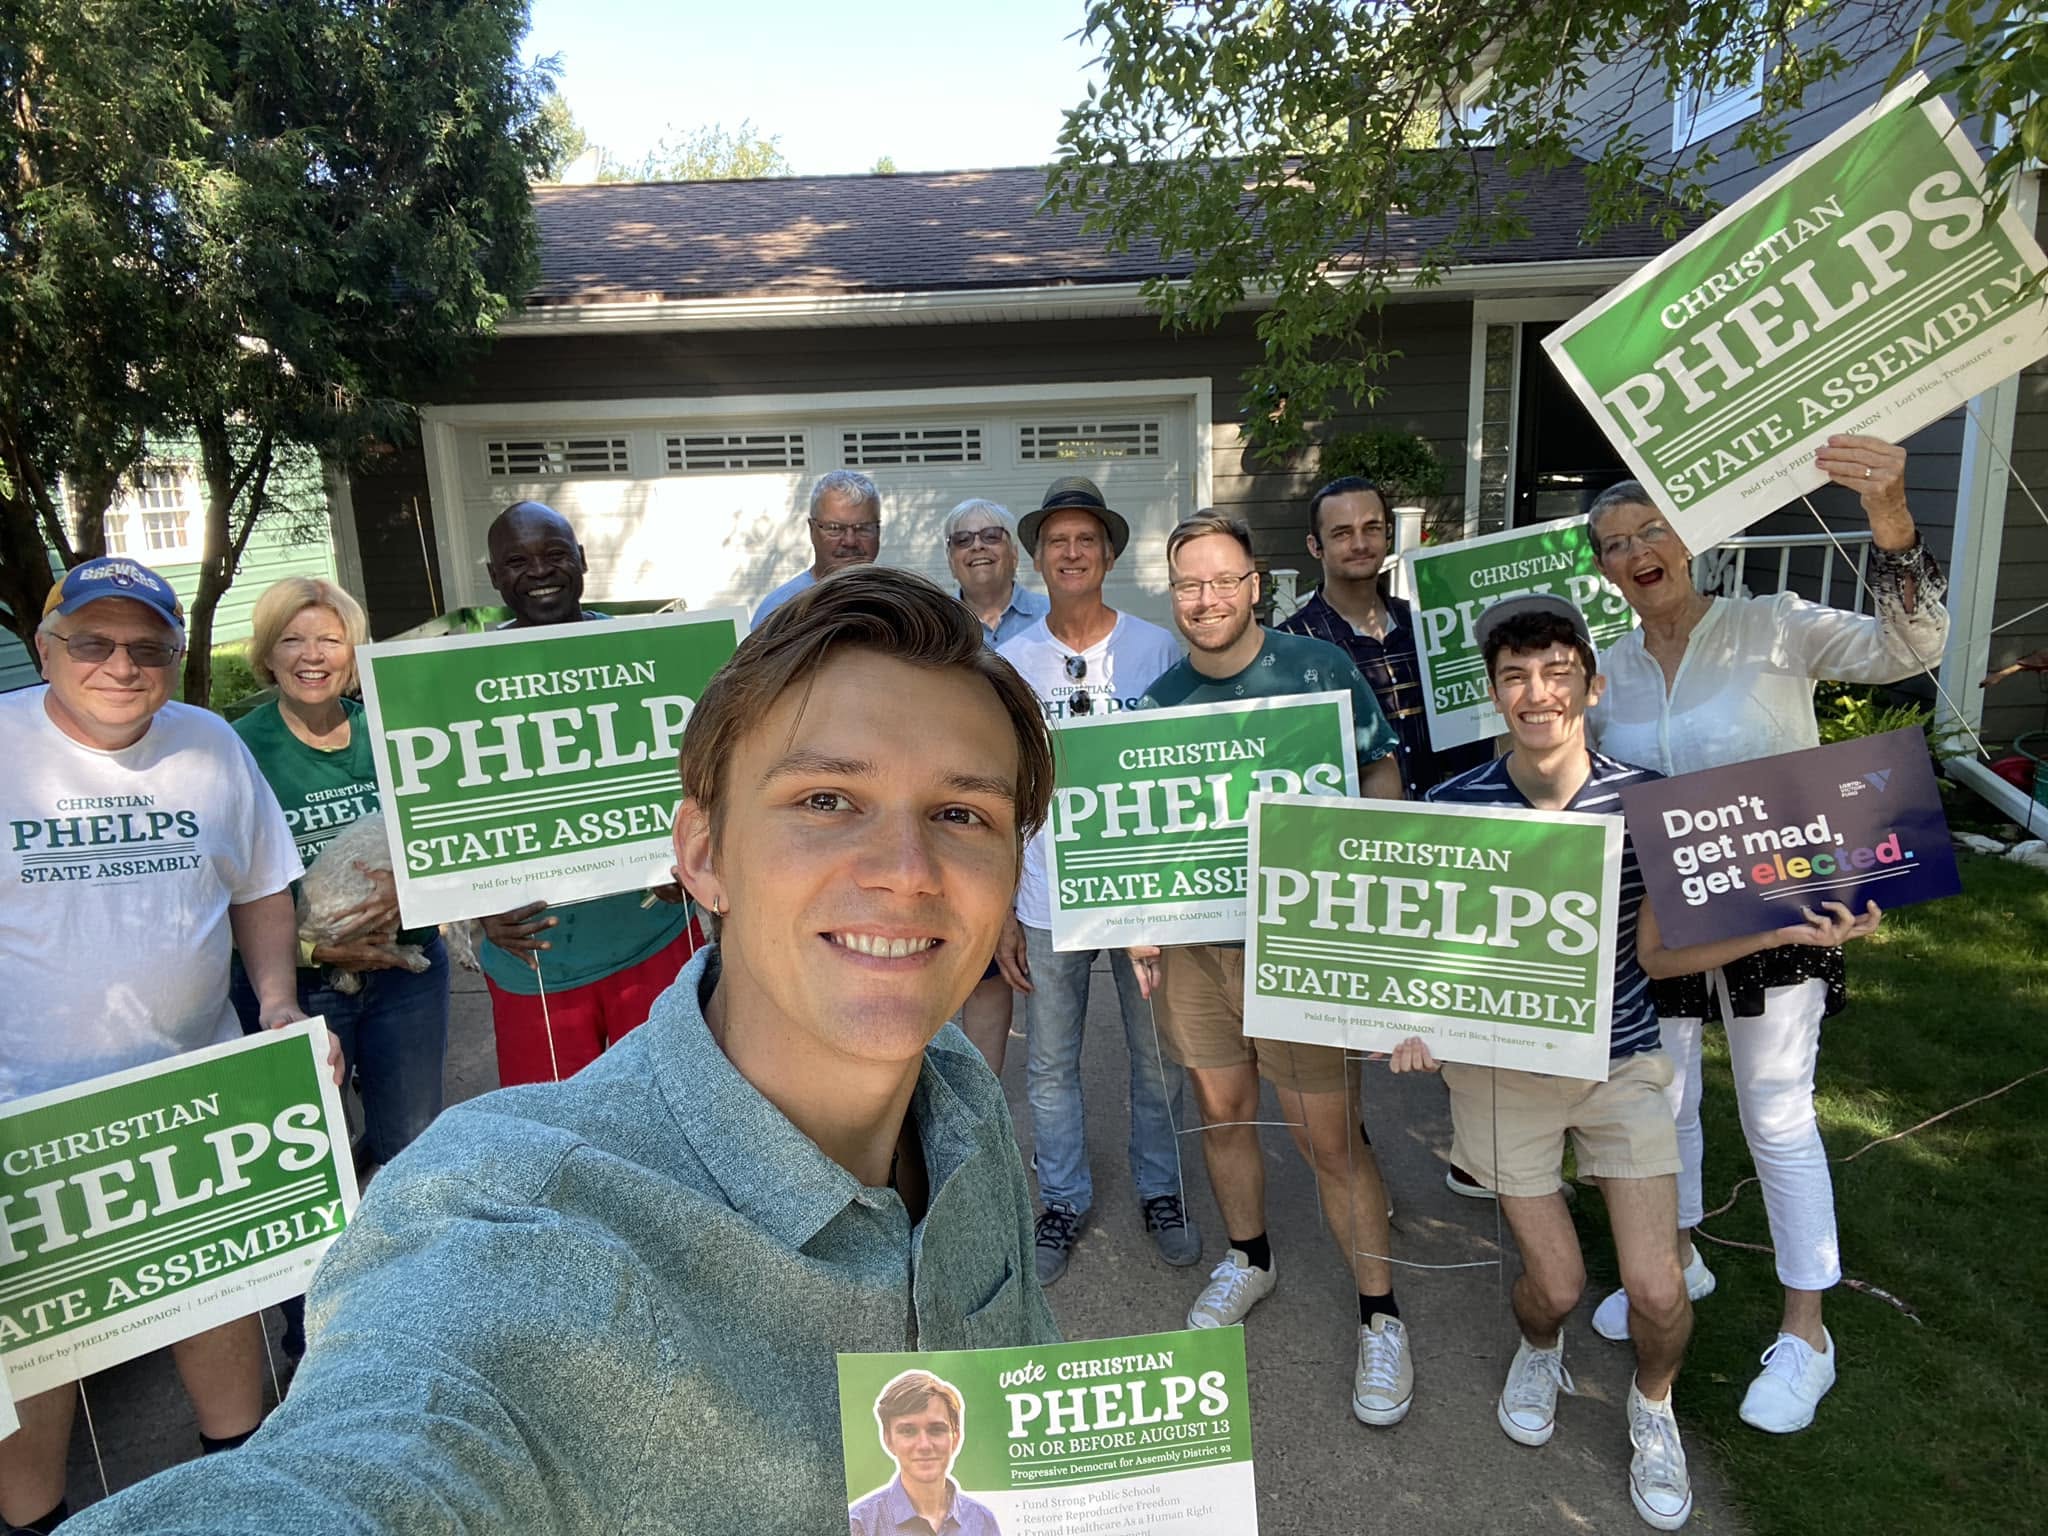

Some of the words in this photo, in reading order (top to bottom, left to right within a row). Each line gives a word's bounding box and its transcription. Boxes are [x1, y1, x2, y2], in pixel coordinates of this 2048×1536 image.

[1659, 195, 1846, 330] CHRISTIAN
[1603, 171, 1985, 446] PHELPS
[1664, 413, 1794, 505] STATE
[1797, 263, 2029, 430] ASSEMBLY
[1740, 482, 1762, 498] Paid
[1761, 476, 1776, 487] for
[1775, 467, 1788, 478] by
[1894, 389, 1917, 408] Lori
[1941, 347, 1993, 380] Treasurer
[80, 563, 161, 592] BREWERS
[1469, 550, 1575, 589] CHRISTIAN
[475, 660, 656, 704] CHRISTIAN
[1434, 676, 1491, 709] STAT
[385, 695, 698, 796] PHELP
[1119, 737, 1266, 771] CHRISTIAN
[56, 794, 155, 812] CHRISTIAN
[305, 781, 377, 803] CHRISTIAN
[9, 810, 200, 852] PHELPS
[407, 823, 541, 872] STATE
[550, 800, 683, 850] ASSEM
[1662, 795, 1768, 839] Don't
[1338, 838, 1513, 873] CHRISTIAN
[1672, 834, 1737, 876] get
[1742, 814, 1845, 855] mad,
[20, 865, 92, 884] STATE
[95, 855, 202, 879] ASSEMBLY
[472, 880, 493, 891] Paid
[495, 878, 509, 887] for
[511, 875, 522, 885] by
[525, 869, 563, 882] PHELPS
[564, 859, 616, 875] CAMPAIGN
[629, 854, 648, 864] Lori
[1060, 871, 1163, 905] STATE
[1681, 865, 1746, 906] get
[1751, 833, 1915, 885] elected.
[1106, 917, 1122, 926] Paid
[1124, 917, 1134, 925] for
[1136, 917, 1146, 926] by
[1148, 913, 1178, 924] PHELPS
[1180, 911, 1222, 921] CAMPAIGN
[1258, 867, 1599, 957] PHELPS
[1257, 963, 1370, 1001] STATE
[1378, 975, 1596, 1028] ASSEMBLY
[1304, 1012, 1323, 1021] Paid
[1324, 1014, 1337, 1023] for
[1337, 1015, 1347, 1026] by
[1349, 1017, 1385, 1028] PHELPS
[1386, 1022, 1435, 1034] CAMPAIGN
[1449, 1029, 1467, 1038] Lori
[1490, 1034, 1537, 1047] Treasurer
[3, 1092, 221, 1176] CHRISTIAN
[0, 1103, 331, 1267] HELPS
[103, 1199, 343, 1311] ASSEMBLY
[10, 1358, 36, 1374] Paid
[37, 1354, 55, 1366] for
[56, 1346, 72, 1359] by
[74, 1329, 119, 1351] PHELPS
[121, 1305, 182, 1334] CAMPAIGN
[197, 1289, 219, 1305] Lori
[247, 1265, 294, 1288] Treasurer
[999, 1359, 1047, 1388] vote
[1057, 1351, 1174, 1380] CHRISTIAN
[1005, 1370, 1229, 1438] PHELPS
[1008, 1442, 1035, 1458] ON
[1039, 1440, 1066, 1456] OR
[1069, 1432, 1136, 1454] BEFORE
[1140, 1422, 1207, 1444] AUGUST
[1211, 1419, 1230, 1434] 13
[1010, 1466, 1068, 1480] Progressive
[1070, 1460, 1118, 1474] Democrat
[1119, 1457, 1134, 1468] for
[1135, 1451, 1181, 1466] Assembly
[1182, 1446, 1219, 1459] District
[1219, 1444, 1231, 1454] 93
[1023, 1513, 1063, 1524] Restore
[1065, 1503, 1134, 1522] Reproductive
[1136, 1497, 1181, 1511] Freedom
[1050, 1496, 1086, 1508] Strong
[1088, 1489, 1120, 1504] Public
[1122, 1484, 1160, 1498] Schools
[1066, 1520, 1121, 1535] Healthcare
[1124, 1517, 1136, 1527] As
[1138, 1517, 1144, 1525] a
[1146, 1511, 1184, 1523] Human
[1186, 1505, 1215, 1518] Right
